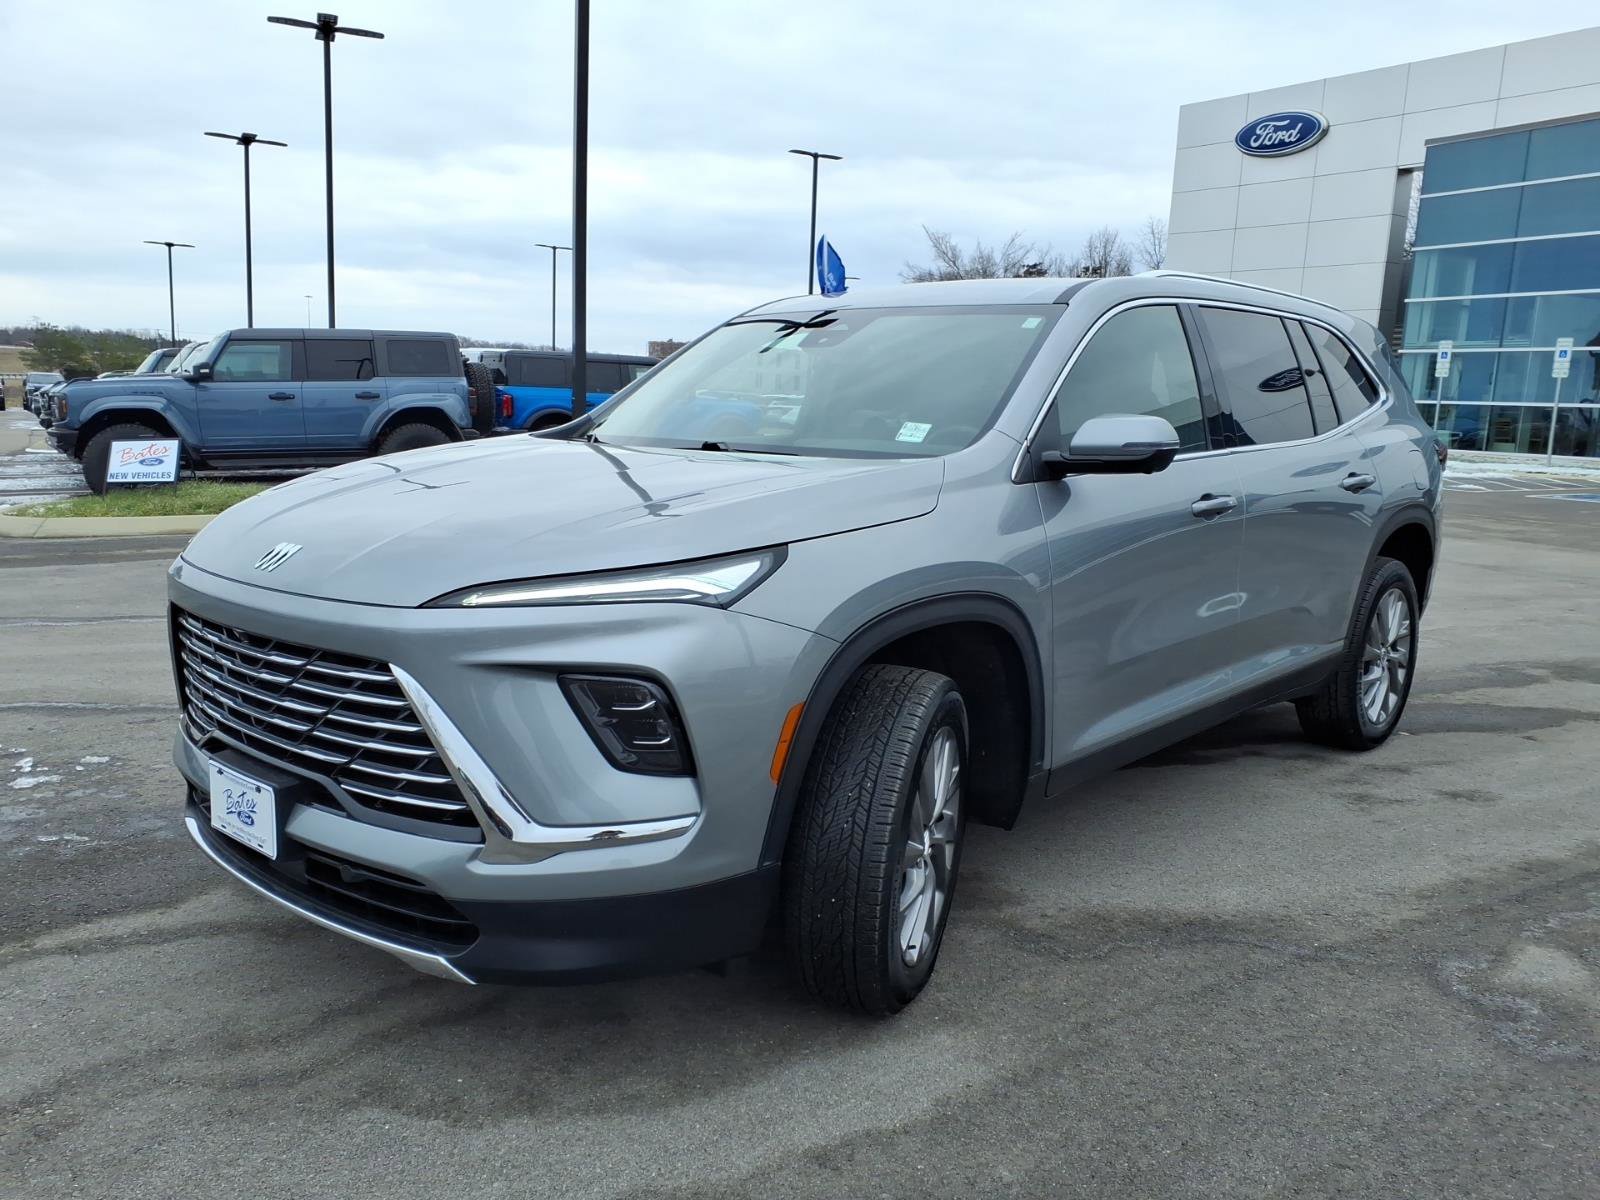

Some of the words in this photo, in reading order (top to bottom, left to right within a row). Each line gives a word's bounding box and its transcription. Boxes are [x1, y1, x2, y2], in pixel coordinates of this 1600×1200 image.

[1250, 119, 1303, 147] Ford
[119, 443, 169, 464] Bates
[109, 472, 129, 480] NEW
[131, 471, 172, 479] VEHICLES
[223, 788, 257, 810] Bates
